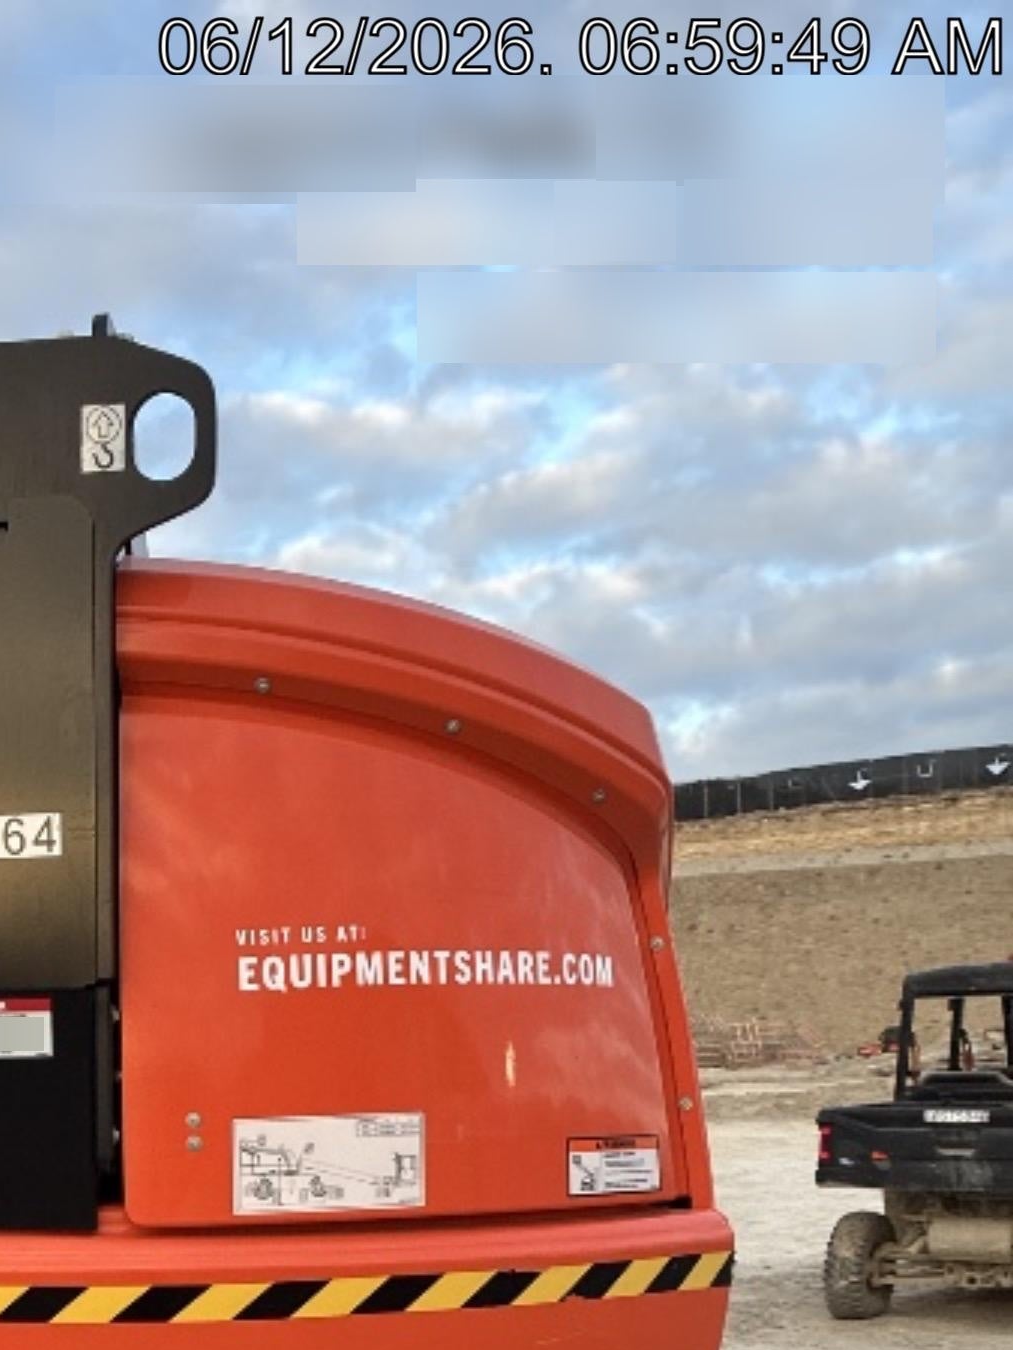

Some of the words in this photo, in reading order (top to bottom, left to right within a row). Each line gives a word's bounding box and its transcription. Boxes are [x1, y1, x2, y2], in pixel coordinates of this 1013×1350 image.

[235, 927, 291, 946] VISIT
[300, 927, 328, 943] US
[336, 925, 367, 942] AT:
[237, 950, 613, 992] EQUIPMENTSHARE.COM
